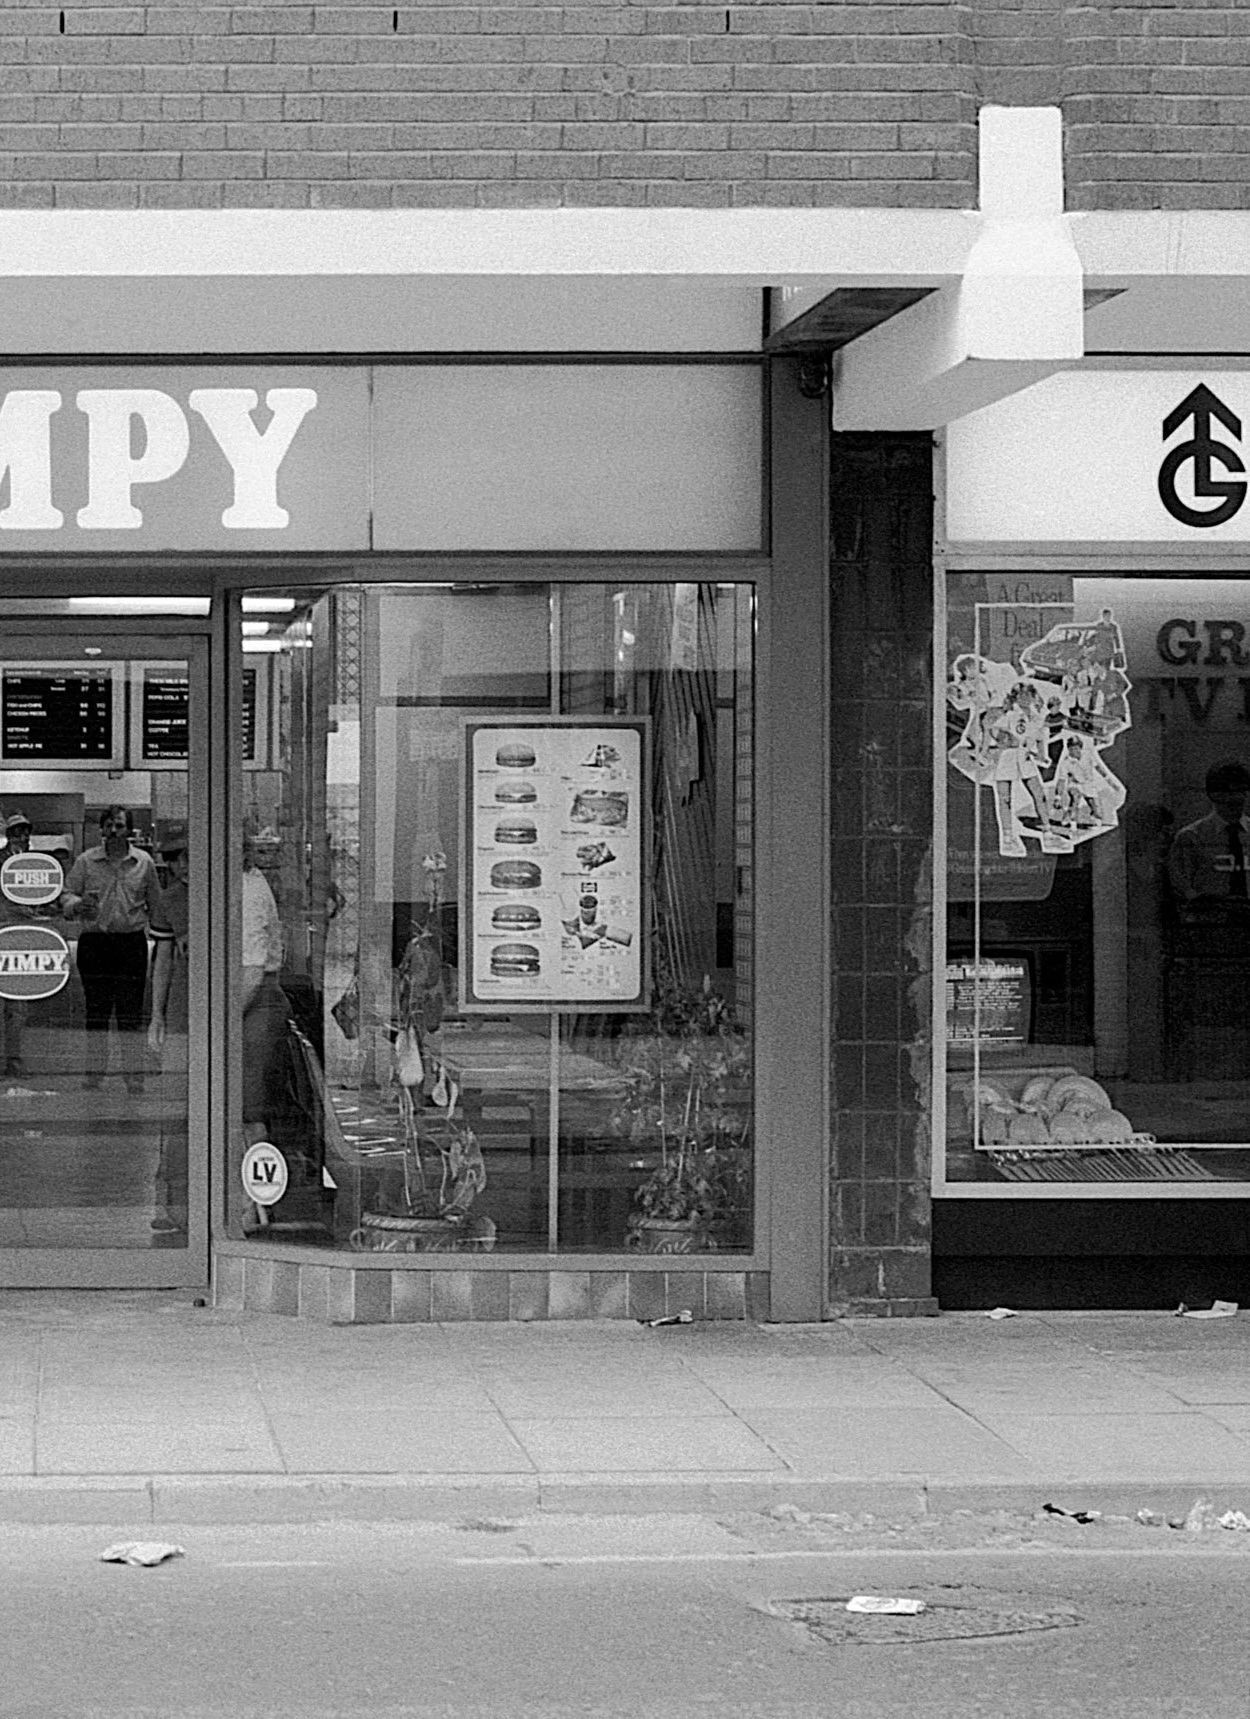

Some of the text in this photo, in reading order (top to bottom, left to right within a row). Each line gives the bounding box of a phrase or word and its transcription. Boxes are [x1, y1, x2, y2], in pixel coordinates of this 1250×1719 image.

[1156, 617, 1250, 666] GR
[14, 872, 49, 885] PUSH
[253, 1161, 277, 1183] LV
